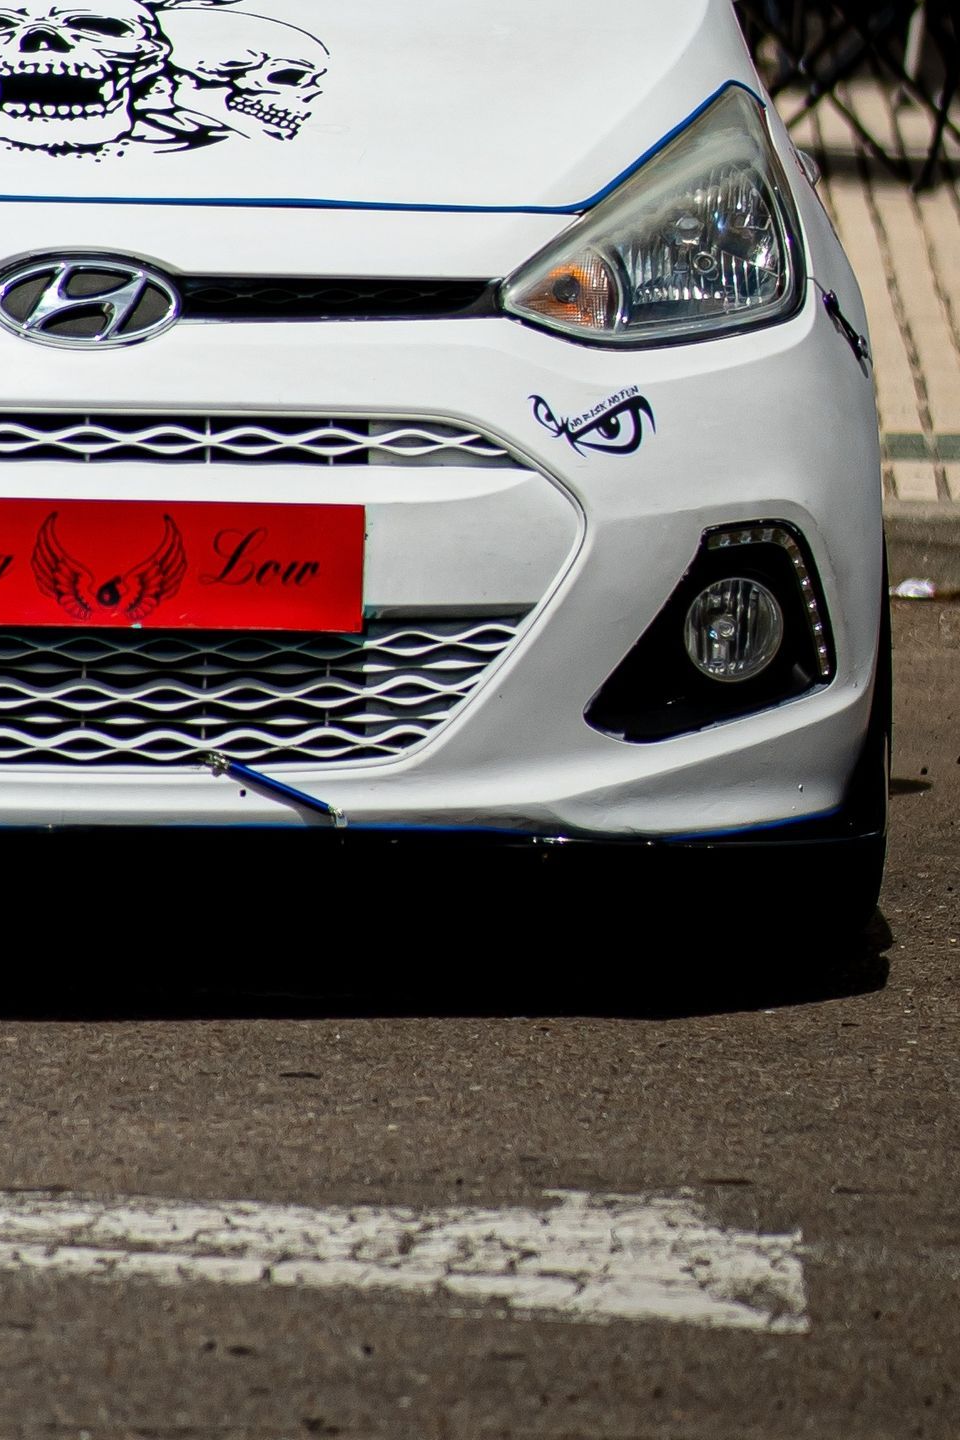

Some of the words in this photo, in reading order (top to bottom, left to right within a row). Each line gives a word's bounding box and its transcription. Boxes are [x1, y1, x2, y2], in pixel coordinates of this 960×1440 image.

[569, 417, 583, 430] NO
[607, 394, 620, 406] NO
[618, 385, 639, 399] FUN
[198, 527, 321, 588] Low
